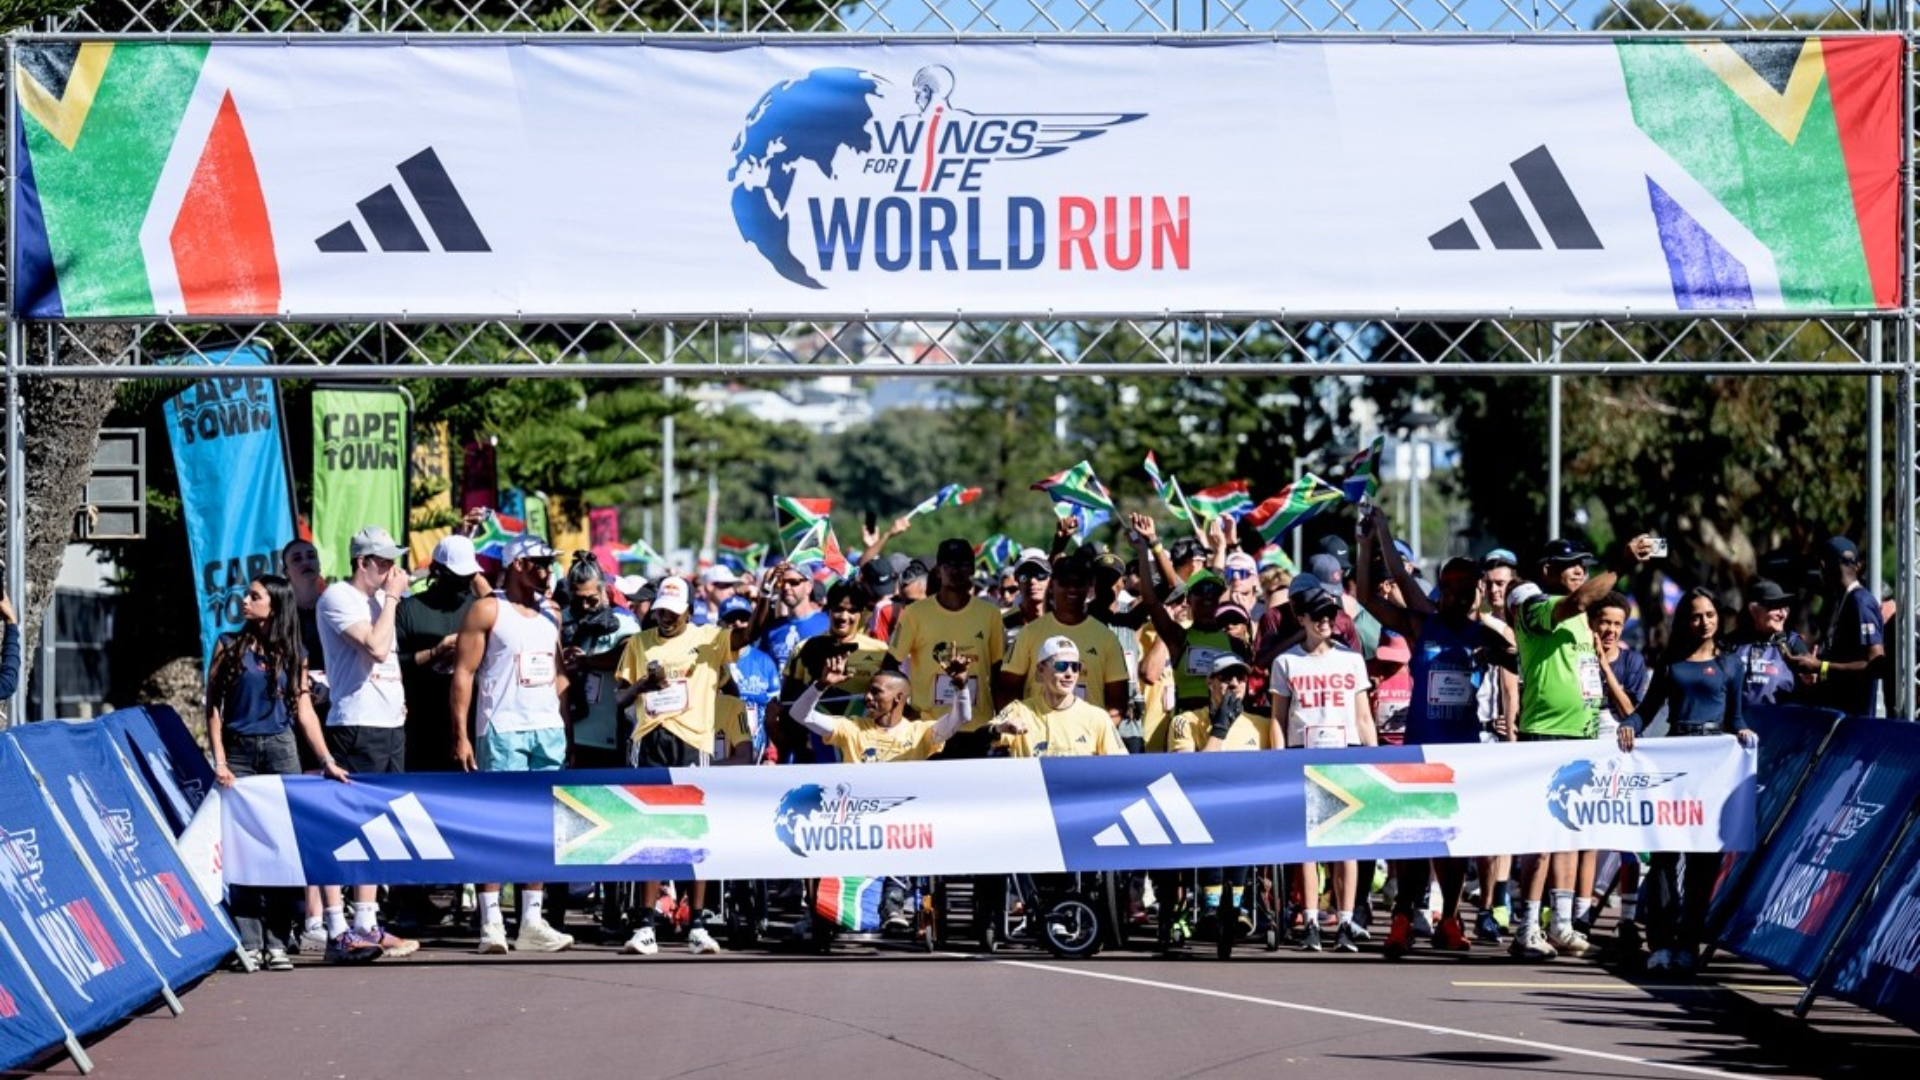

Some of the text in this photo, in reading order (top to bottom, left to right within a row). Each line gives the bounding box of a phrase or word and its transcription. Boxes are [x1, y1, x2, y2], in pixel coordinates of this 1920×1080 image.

[863, 159, 899, 174] FOR
[808, 195, 1190, 272] WORLD RUN
[178, 402, 271, 444] TOWN
[323, 413, 400, 441] CAPE
[323, 442, 398, 470] TOWN
[208, 592, 246, 628] TO
[1289, 673, 1355, 690] WINGS
[1300, 691, 1345, 708] LIFE
[1574, 799, 1704, 826] WORLD RUN
[802, 823, 933, 851] WORLD RUN
